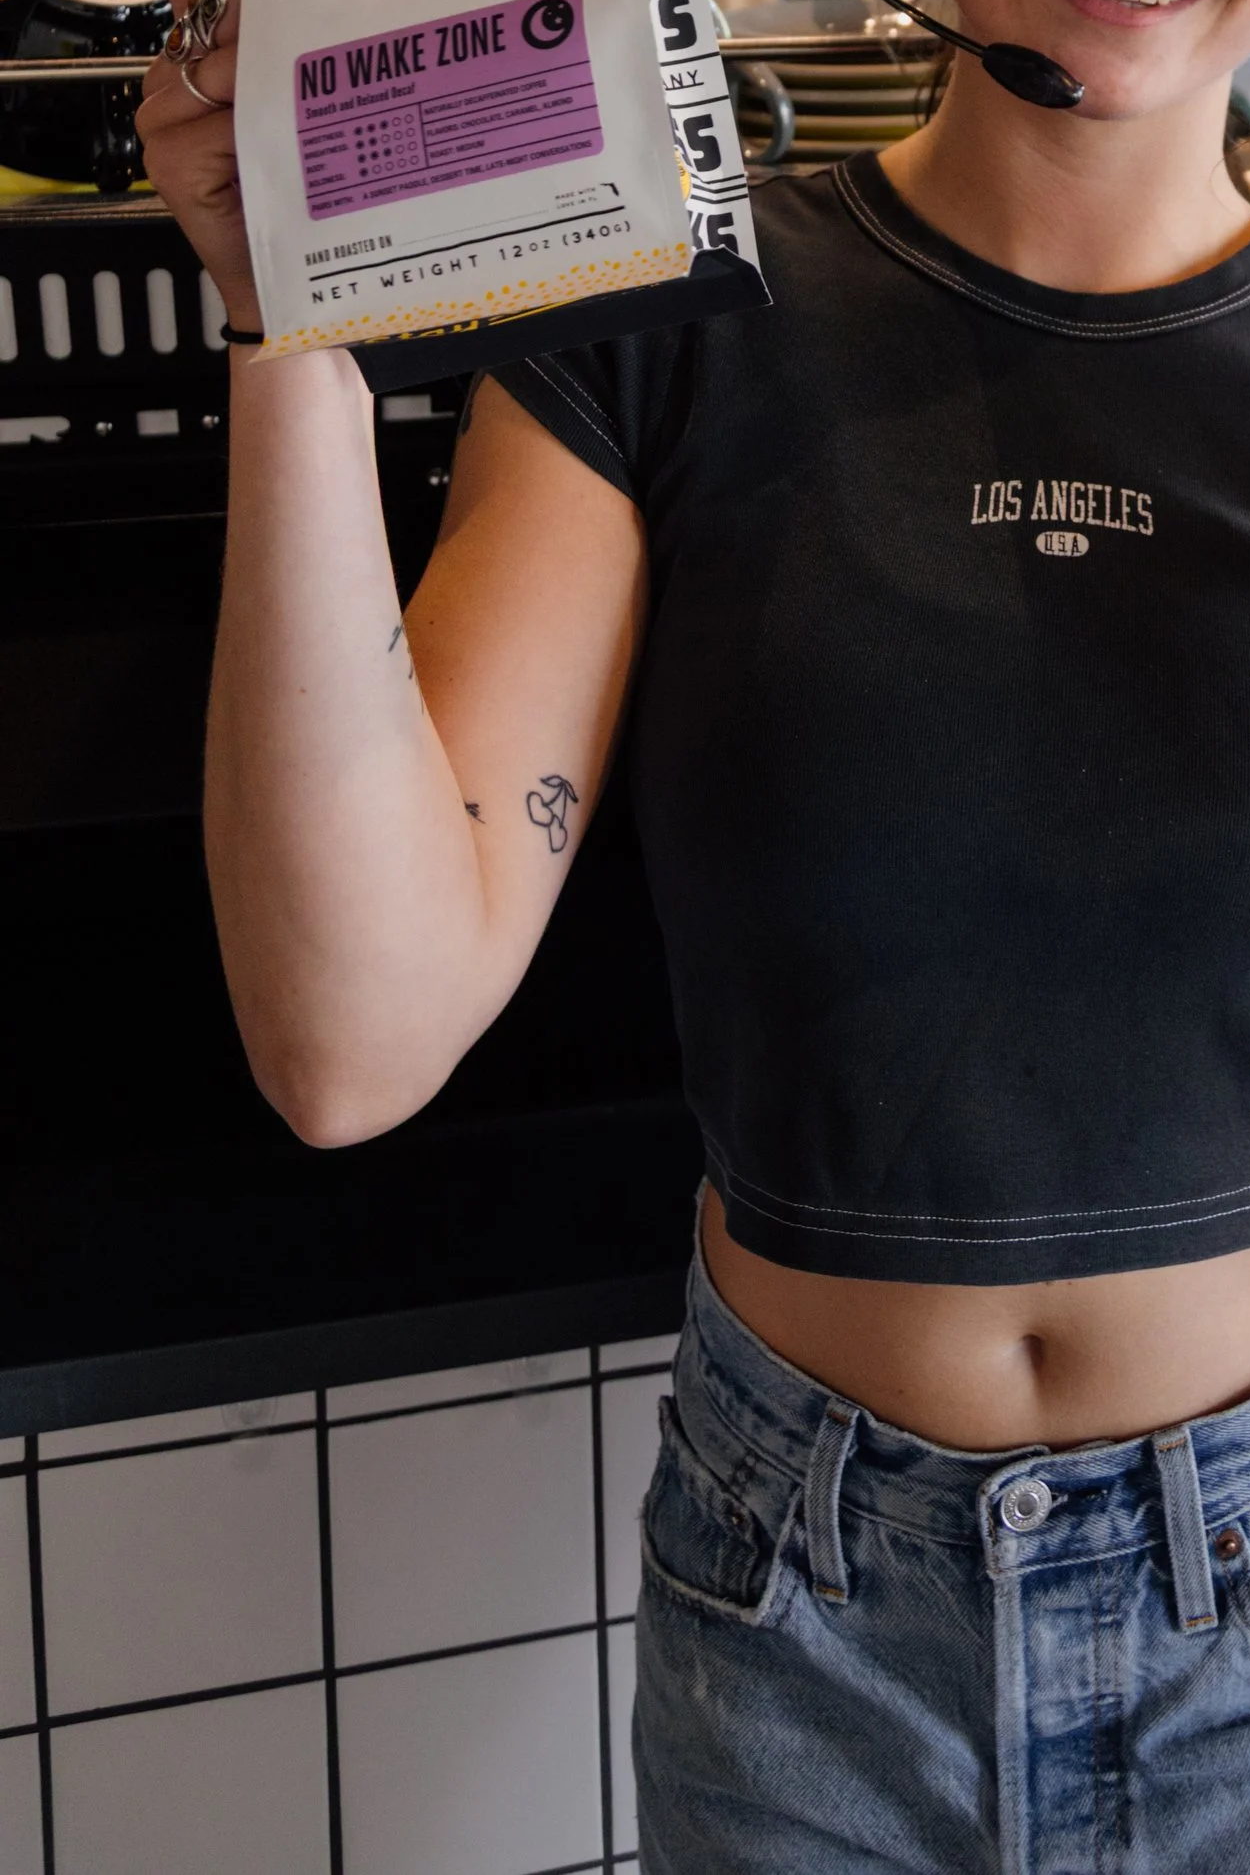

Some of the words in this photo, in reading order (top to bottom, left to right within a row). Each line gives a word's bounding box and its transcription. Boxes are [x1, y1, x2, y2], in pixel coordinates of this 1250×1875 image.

[300, 55, 337, 101] NO
[346, 32, 427, 89] WAKE
[435, 13, 506, 67] ZONE
[306, 102, 337, 120] Smooth
[339, 98, 355, 112] and
[356, 90, 390, 106] Relaxed
[391, 82, 416, 98] Decaf
[424, 100, 462, 115] NATURALLY
[464, 86, 519, 106] DECAFFEINATED
[520, 79, 548, 92] COFFEE
[461, 112, 503, 130] CHOCOLATE,
[505, 104, 541, 121] CARAMEL,
[543, 96, 574, 110] ALMOND
[430, 170, 463, 185] DESSERT
[465, 163, 485, 175] TIME,
[486, 155, 528, 171] LATE-NIGHT
[530, 139, 593, 161] CONVERSATIONS
[456, 140, 485, 153] MEDIUM
[555, 191, 575, 200] MADE
[304, 250, 332, 267] HAND
[334, 240, 376, 260] ROASTED
[378, 234, 393, 249] ON
[311, 281, 361, 304] NET
[380, 254, 480, 289] WEIGHT
[971, 480, 1023, 525] LOS
[1031, 480, 1154, 536] ANGELES
[1044, 533, 1082, 556] USA
